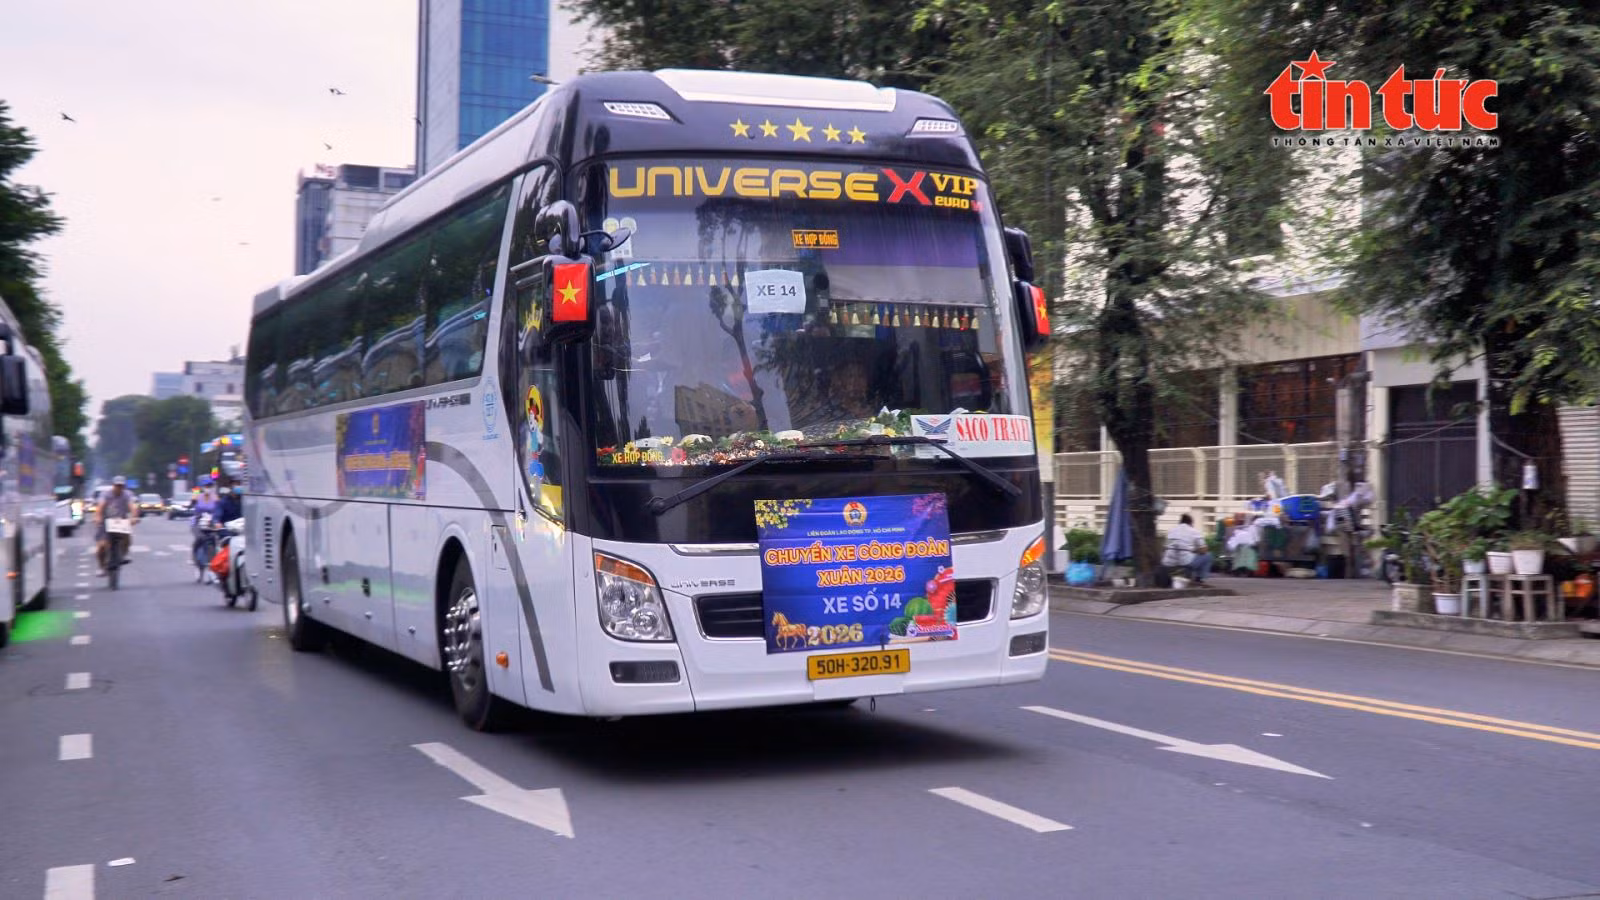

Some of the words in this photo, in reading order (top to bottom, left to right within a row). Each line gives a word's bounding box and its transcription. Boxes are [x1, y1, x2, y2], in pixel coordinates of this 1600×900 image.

[609, 166, 880, 202] UNIVERSE
[880, 168, 933, 206] X
[929, 172, 979, 195] VIP
[756, 285, 776, 296] XE
[780, 285, 797, 296] 14
[955, 417, 989, 441] SACO
[612, 452, 623, 464] XE
[765, 540, 833, 566] CHUYẾN
[834, 544, 857, 562] XE
[858, 540, 903, 560] CÔNG
[905, 537, 950, 558] ĐOÀN
[817, 565, 863, 588] XUÂN
[865, 565, 906, 584] 2026
[823, 597, 848, 614] XE
[852, 587, 879, 612] SỐ
[883, 593, 902, 610] 14
[807, 623, 865, 647] 2026
[816, 654, 902, 675] 50H-320.91
